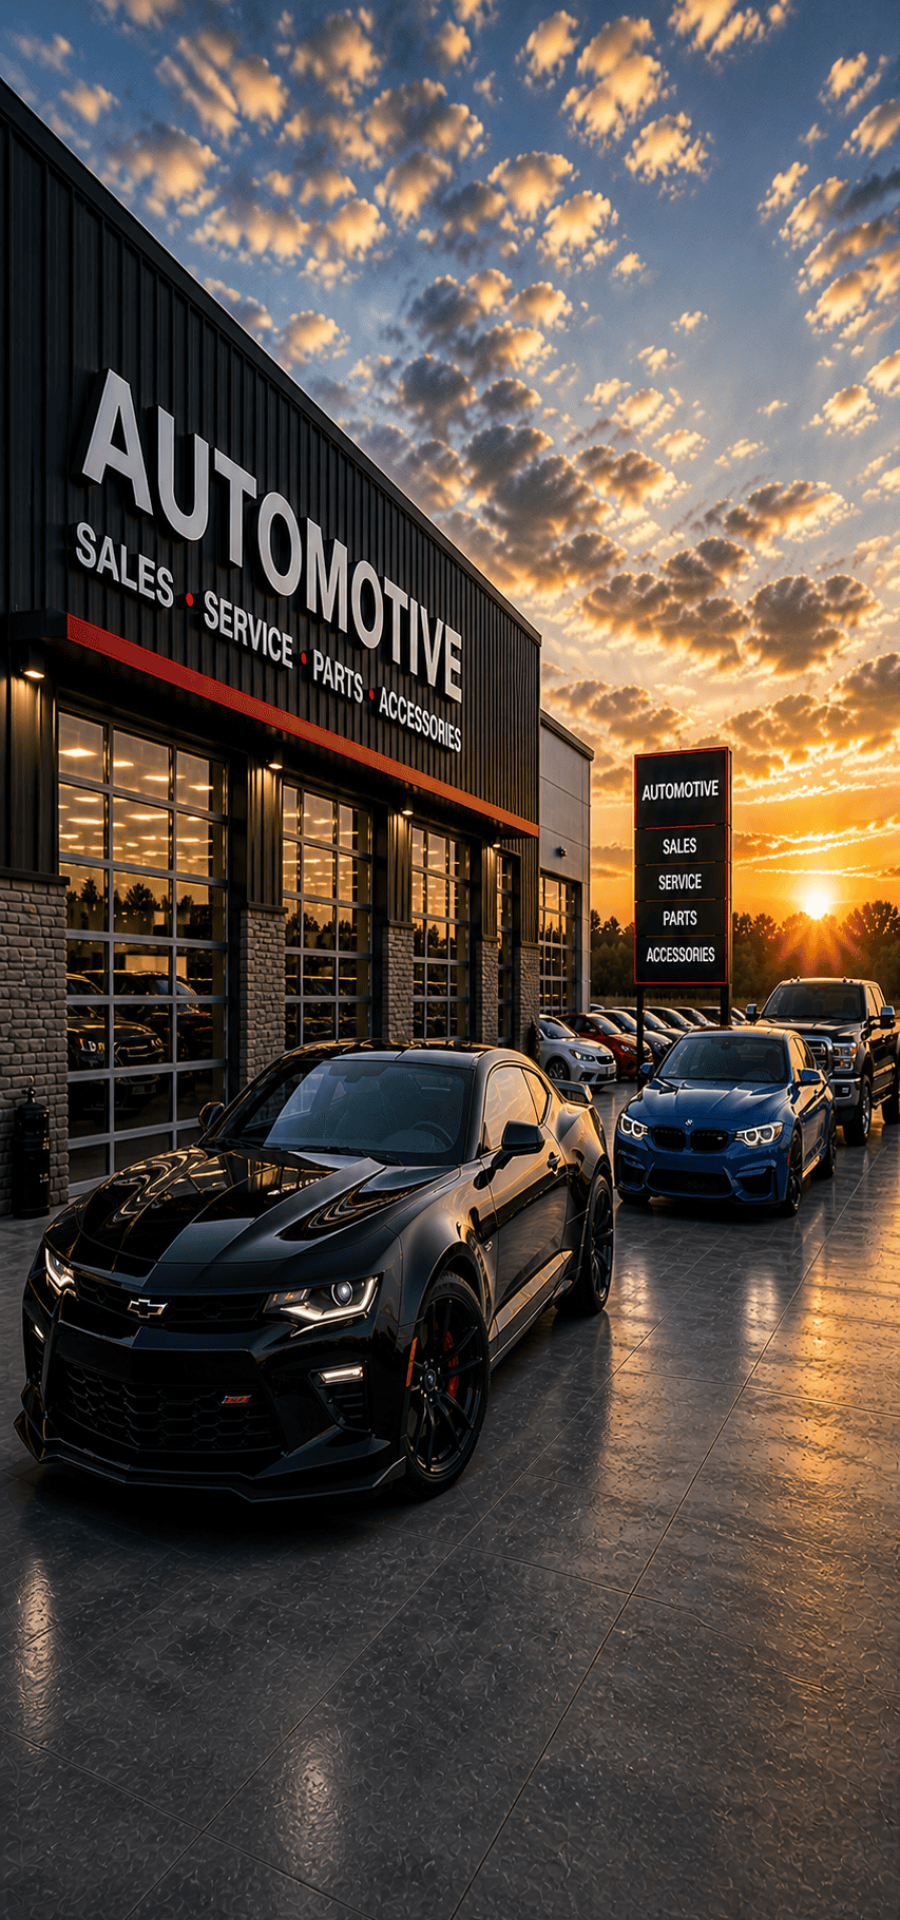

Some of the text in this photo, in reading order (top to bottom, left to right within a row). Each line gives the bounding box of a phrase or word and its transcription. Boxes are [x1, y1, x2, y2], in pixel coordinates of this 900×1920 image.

[81, 368, 462, 704] AUTOMOTIVE
[75, 521, 462, 753] SALES SERVICE PARTS ACCESSORIES
[641, 779, 720, 802] AUTOMOTIVE
[662, 837, 698, 855] SALES
[658, 873, 703, 891] SERVICE
[662, 909, 698, 926] PARTS
[645, 946, 716, 963] ACCESSORIES
